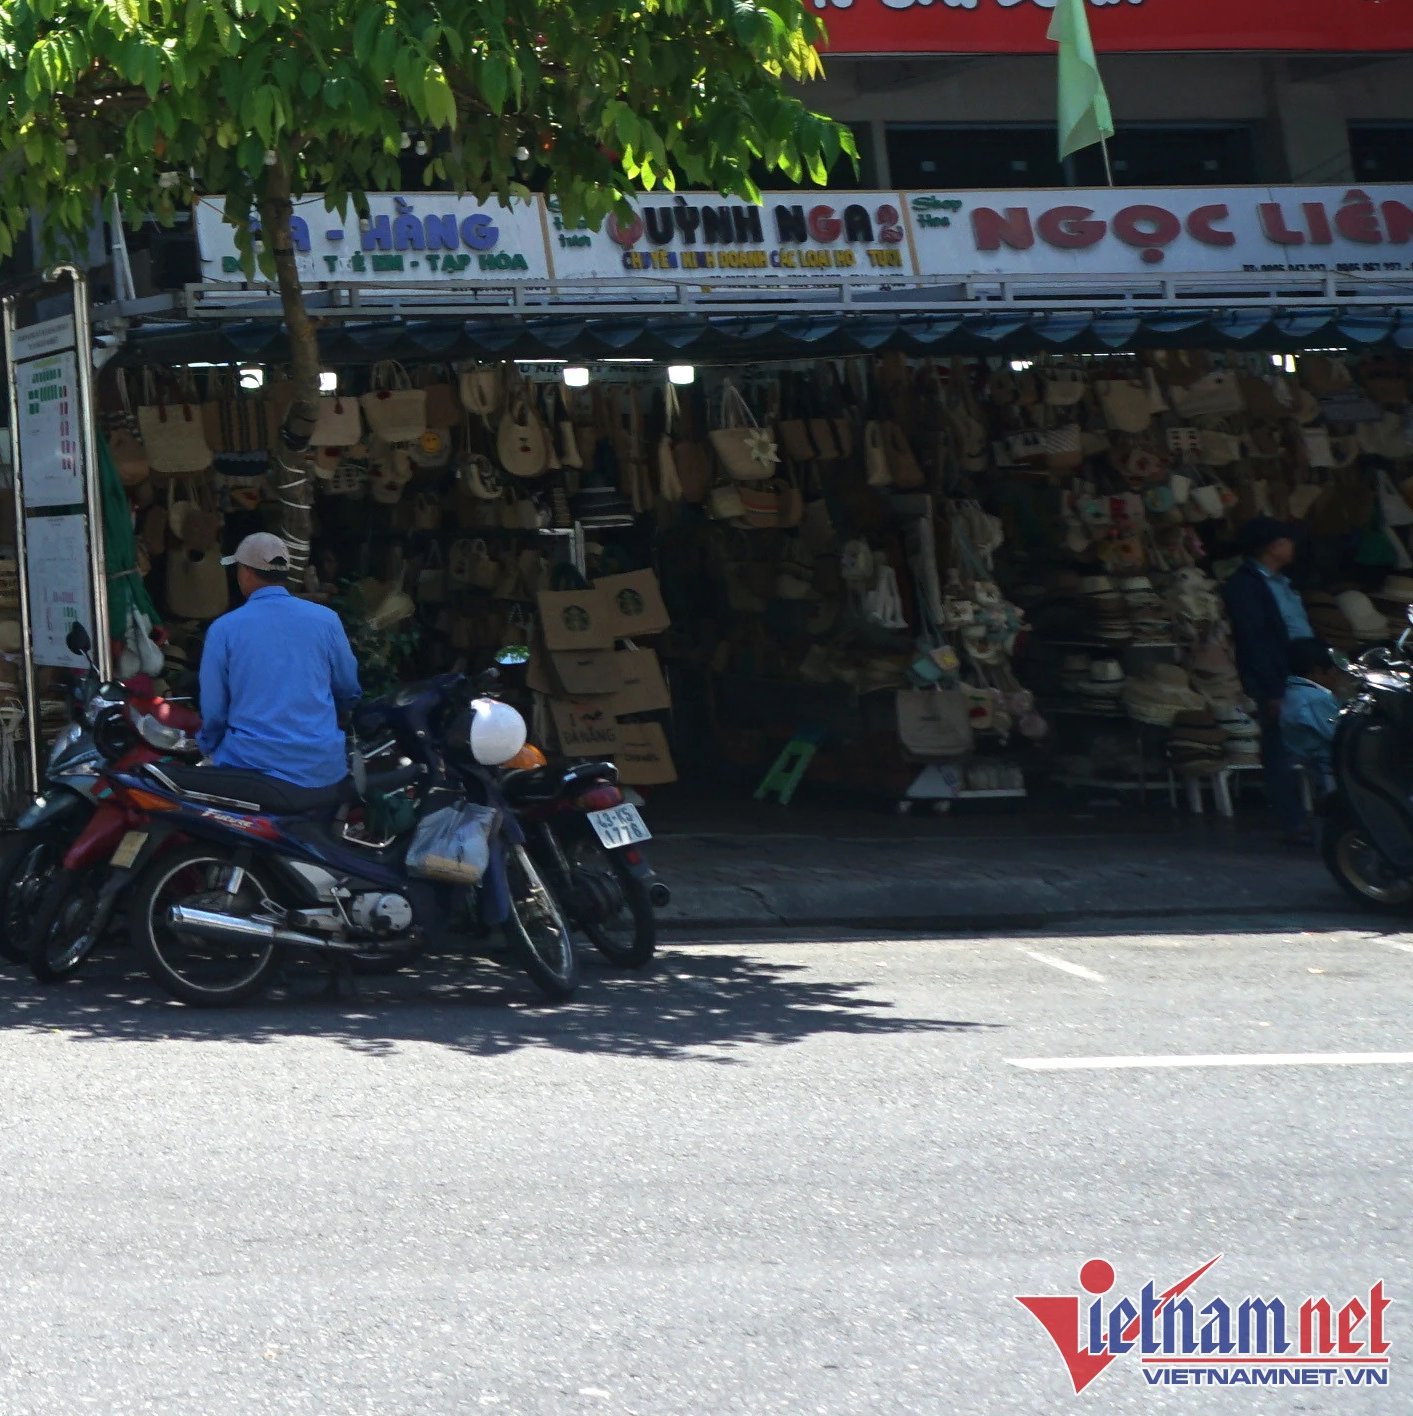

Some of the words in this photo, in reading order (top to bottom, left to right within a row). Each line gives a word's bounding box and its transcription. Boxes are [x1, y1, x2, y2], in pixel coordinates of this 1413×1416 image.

[361, 196, 500, 251] HẰNG
[606, 196, 765, 250] QUỲNH
[775, 203, 875, 244] NGA
[972, 203, 1236, 264] NGỌC
[425, 253, 472, 274] TẠP
[718, 250, 769, 269] DOANH
